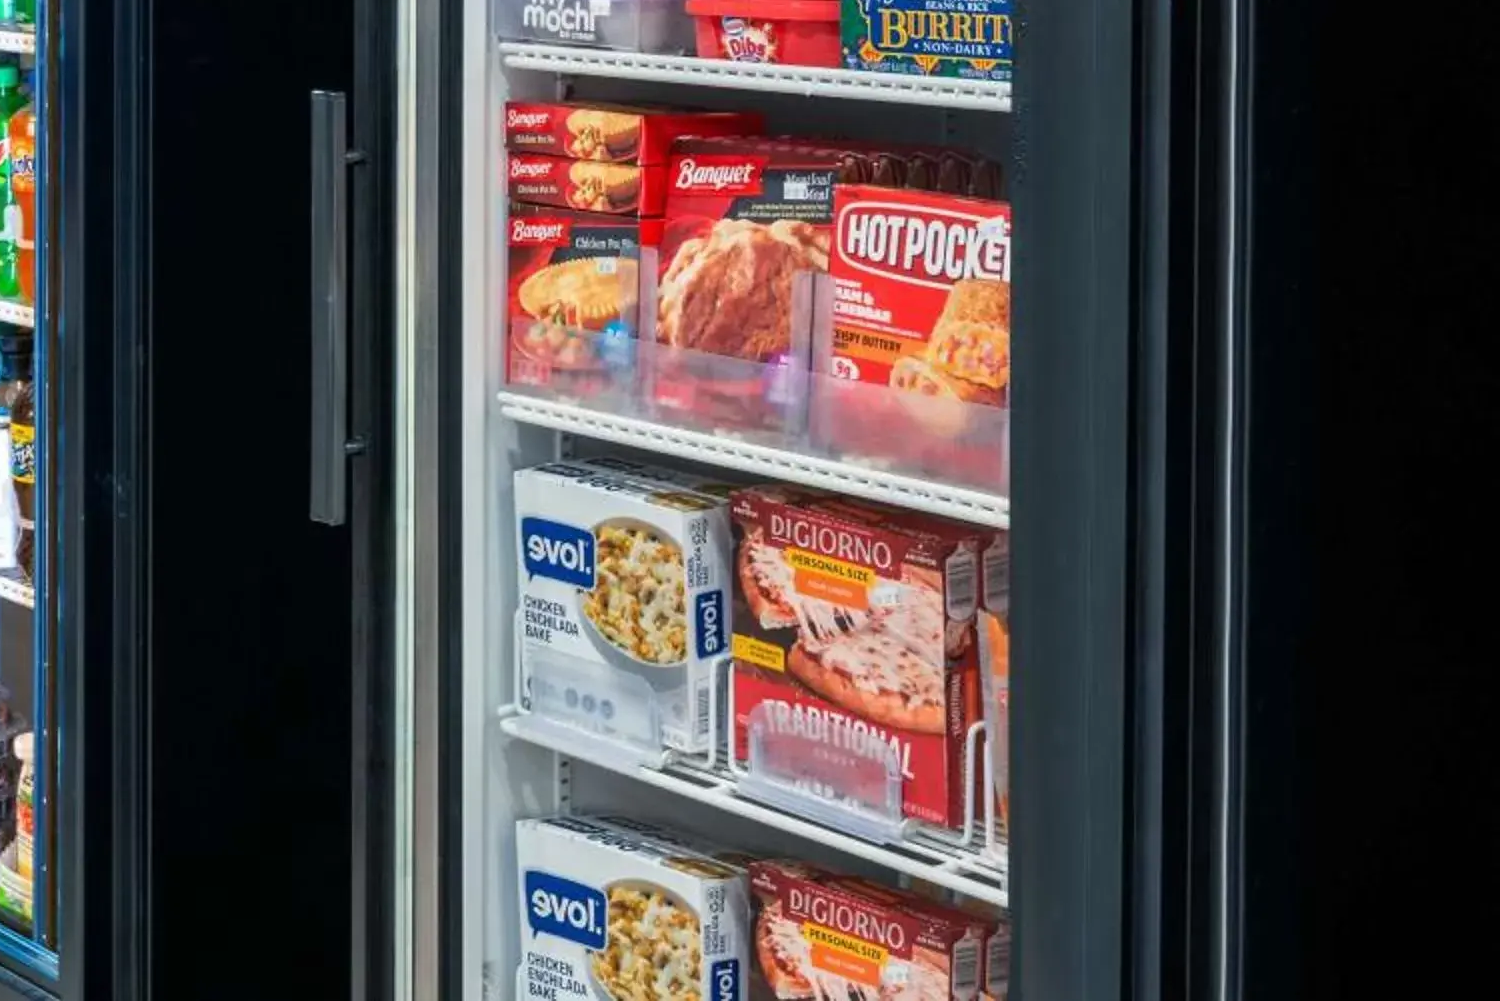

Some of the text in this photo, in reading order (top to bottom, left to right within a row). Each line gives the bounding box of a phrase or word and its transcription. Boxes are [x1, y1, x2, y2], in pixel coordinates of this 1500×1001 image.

[523, 0, 598, 33] mochi
[877, 7, 1013, 49] BURRIT
[729, 37, 767, 59] Dibs
[922, 41, 993, 57] NON-DAIRY
[507, 109, 550, 128] Banquet
[675, 157, 755, 190] Banquet
[511, 220, 564, 242] Banquet
[527, 534, 592, 576] evol.
[791, 551, 872, 584] PERSONAL SIZE
[524, 594, 566, 617] CHICKEN
[524, 609, 579, 637] ENCHILADA
[525, 624, 553, 644] BAKE
[762, 698, 916, 779] TRADITIONAL
[531, 888, 603, 936] evol.
[809, 928, 883, 961] PERSONAL SIZE
[526, 952, 573, 977] CHICKEN
[527, 966, 589, 997] ENCHILADA
[528, 982, 558, 1001] BAKE
